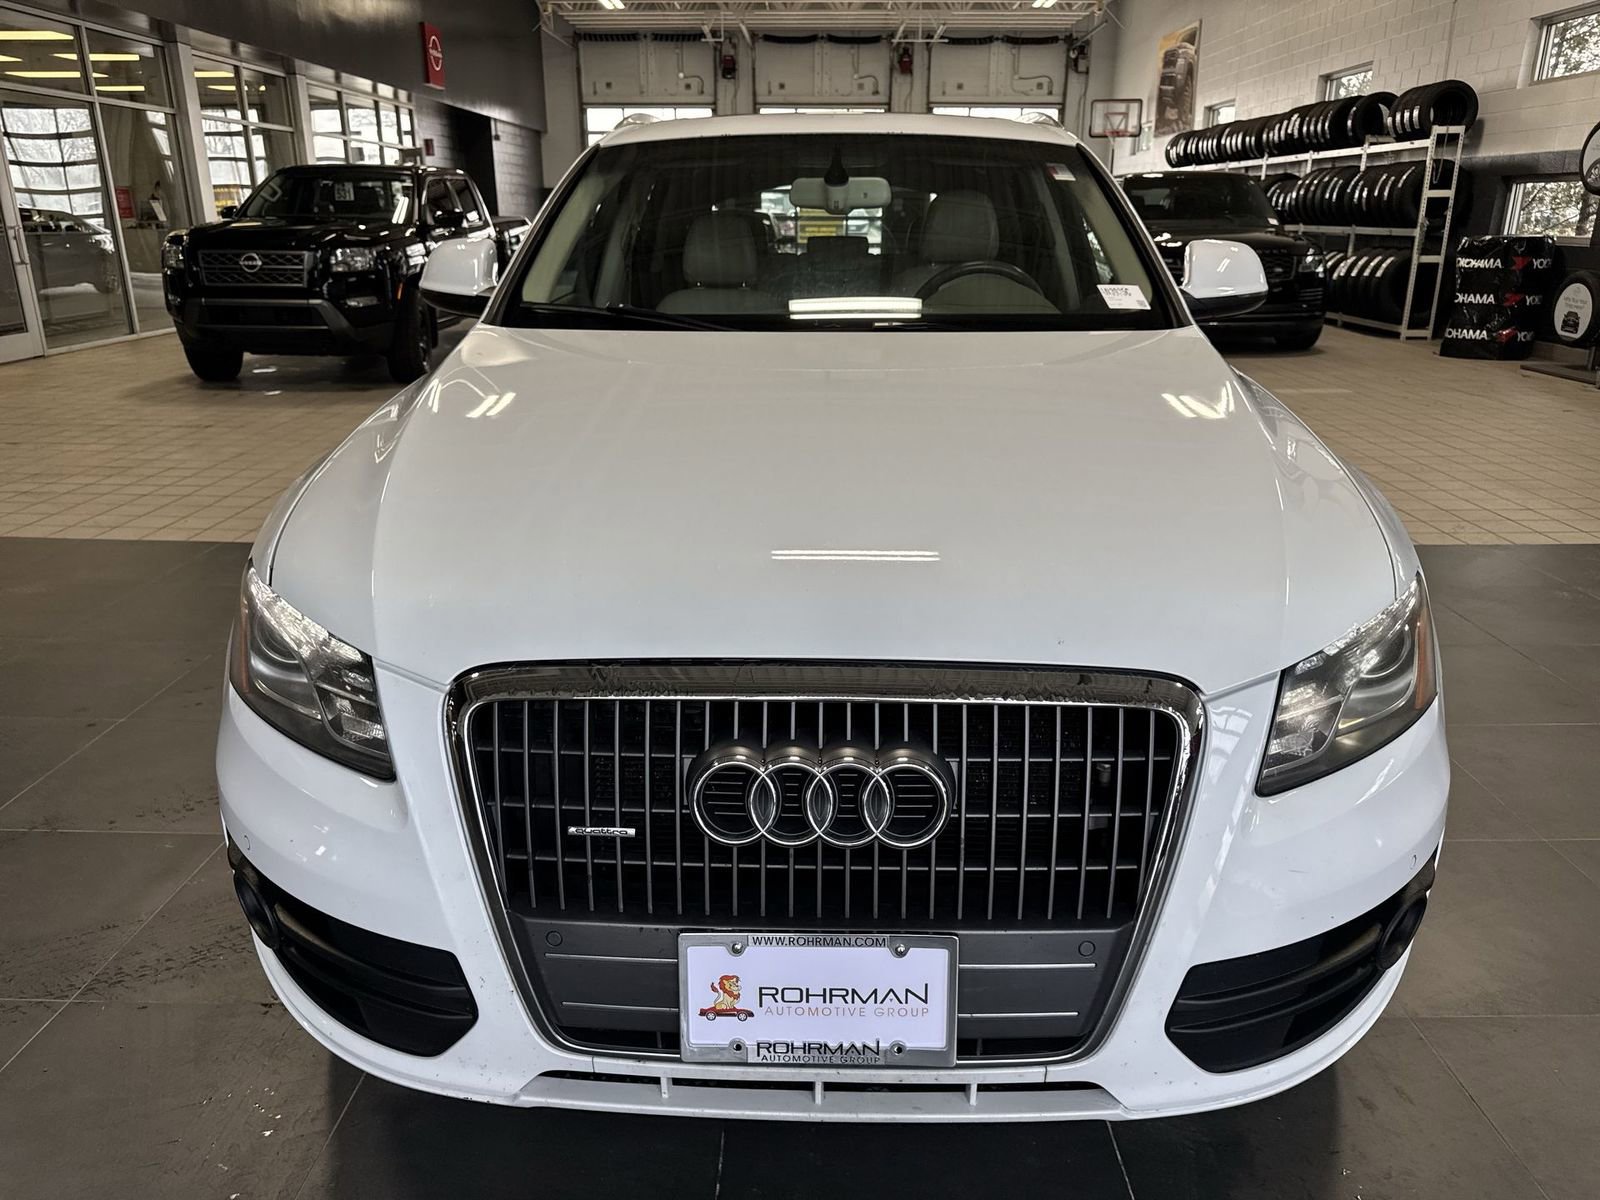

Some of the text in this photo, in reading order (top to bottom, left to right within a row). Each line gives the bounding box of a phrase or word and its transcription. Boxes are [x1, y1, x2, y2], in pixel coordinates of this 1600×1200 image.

[574, 827, 629, 836] quattro
[752, 936, 887, 948] WWW.ROHRMAN.COM
[758, 983, 929, 1008] ROHRMAN
[764, 1006, 929, 1018] AUTOMOTIVE GROUP
[756, 1040, 880, 1057] ROHRMAN
[761, 1054, 881, 1064] AUTOMOTIVE GROUP
